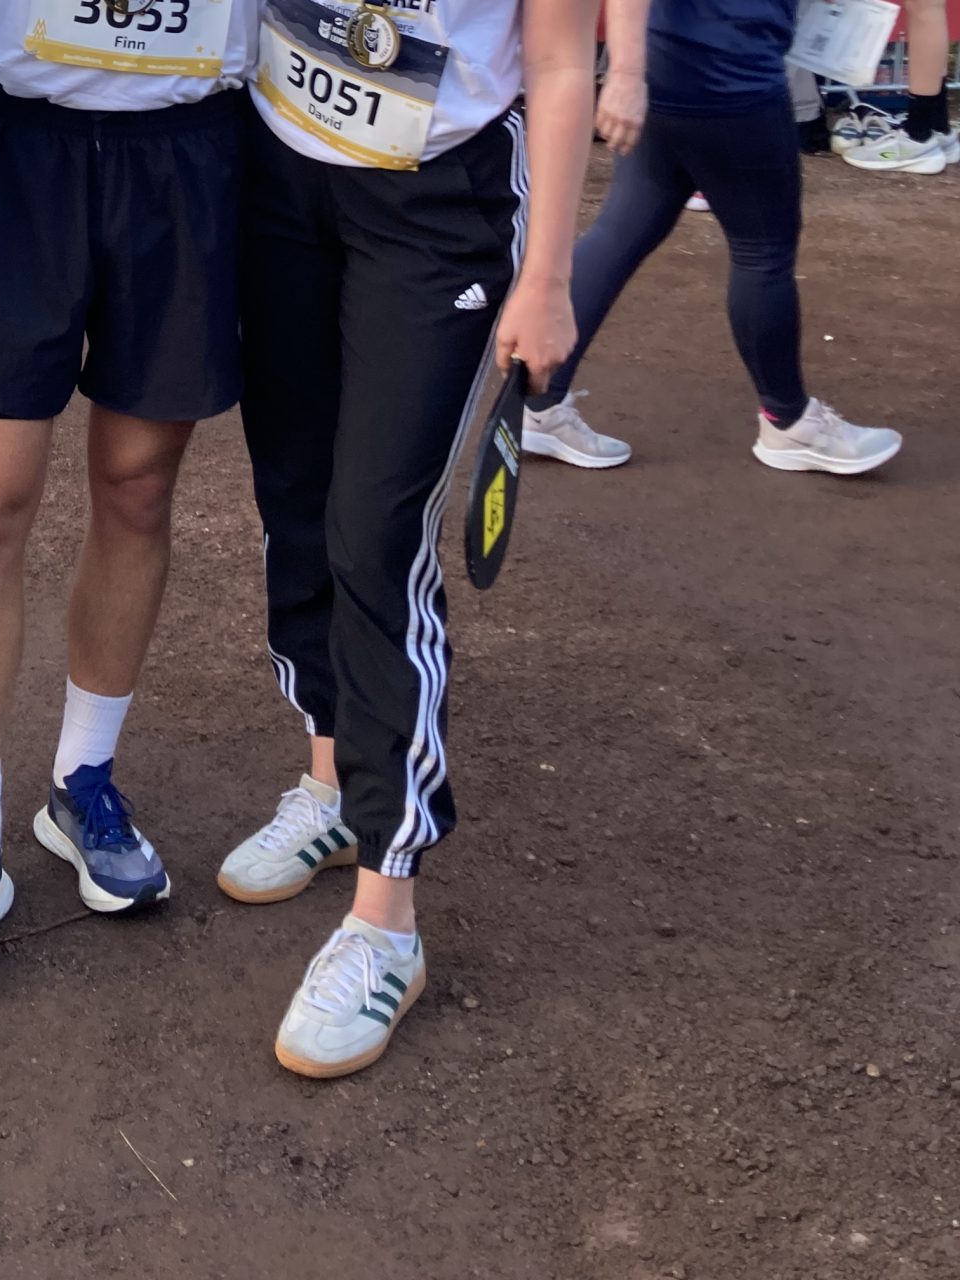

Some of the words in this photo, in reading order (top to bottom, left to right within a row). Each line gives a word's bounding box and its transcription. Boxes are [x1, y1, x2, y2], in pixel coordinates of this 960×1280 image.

[114, 36, 146, 50] Finn
[287, 51, 382, 126] 3051
[308, 103, 342, 131] David
